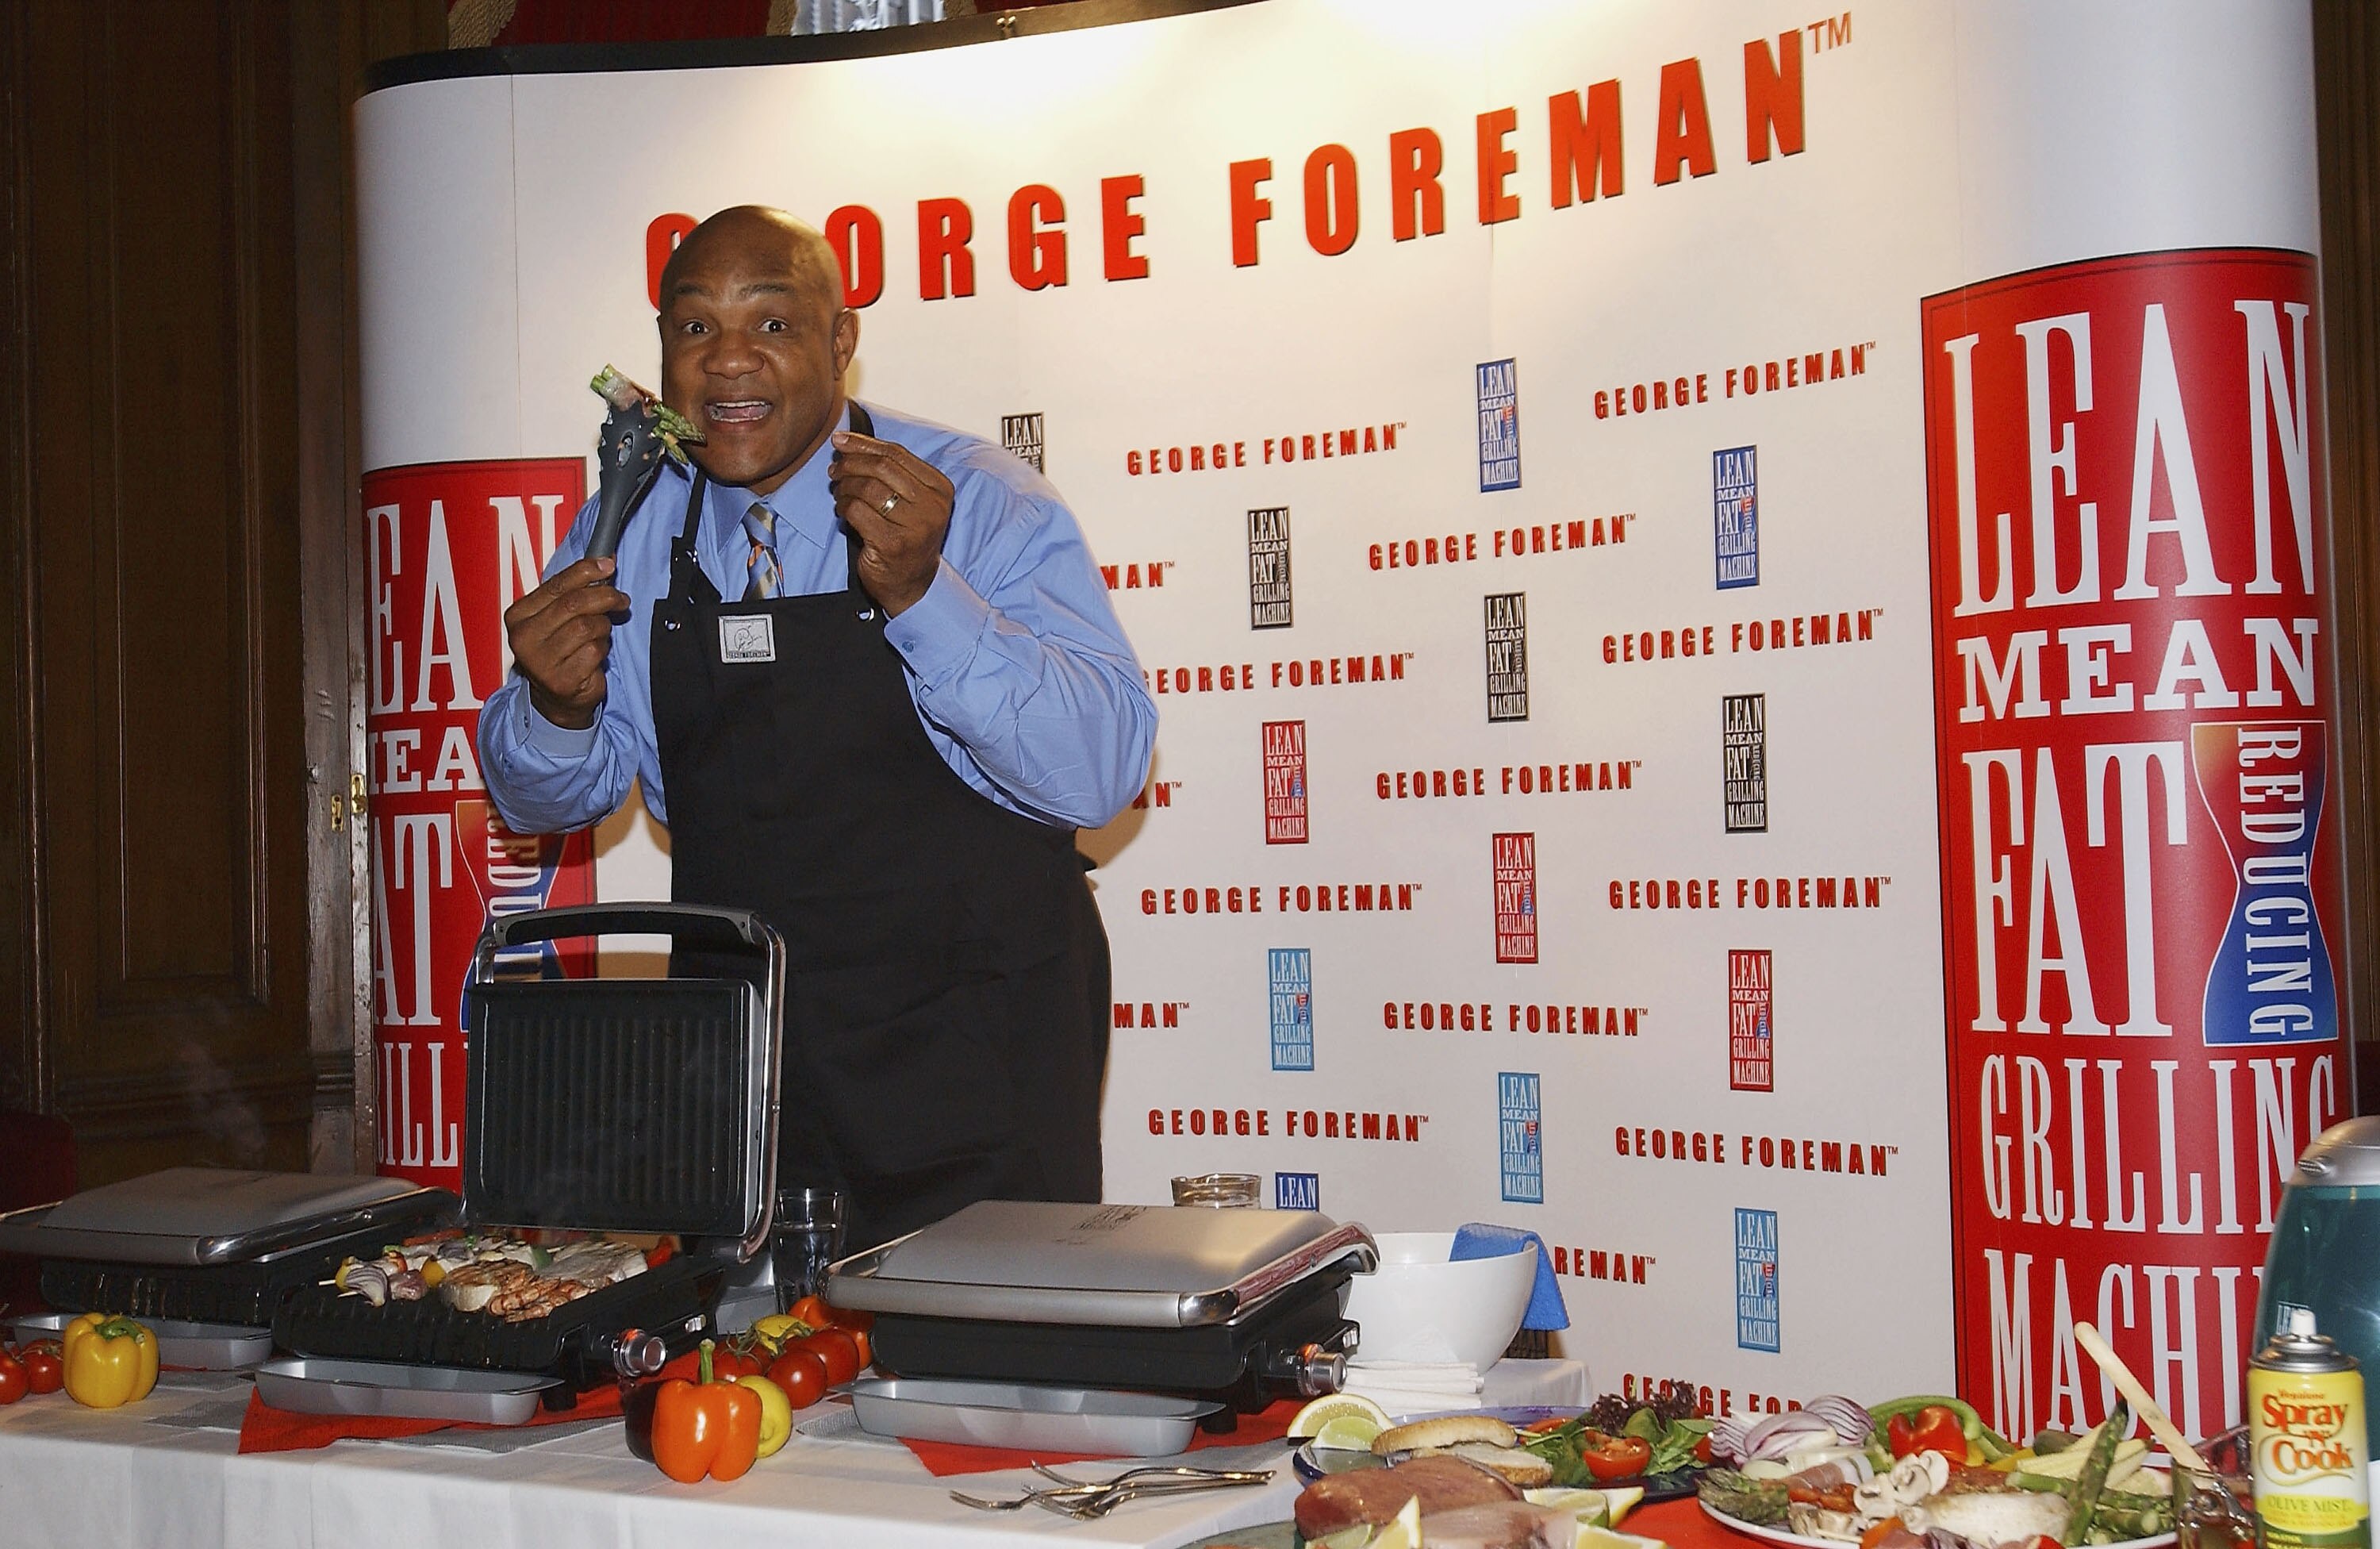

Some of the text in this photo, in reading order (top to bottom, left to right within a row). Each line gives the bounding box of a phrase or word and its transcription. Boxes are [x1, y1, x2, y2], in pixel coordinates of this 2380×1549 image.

[1480, 363, 1514, 398] LEAN
[1480, 396, 1514, 409] MEAN
[1594, 374, 1708, 420] GEORGE
[1004, 416, 1042, 447] LEAN
[1481, 409, 1503, 442] FAT
[1127, 442, 1246, 476] GEORGE
[1484, 438, 1517, 461] GRILLING
[1944, 300, 2315, 617] LEAN
[1484, 459, 1518, 485] MACHINE
[1717, 451, 1754, 489] LEAN
[1718, 486, 1755, 501] MEAN
[1250, 510, 1288, 541] LEAN
[1718, 500, 1741, 535] FAT
[1252, 541, 1288, 552] MEAN
[1368, 533, 1477, 571] GEORGE
[1719, 532, 1756, 555] GRILLING
[1253, 553, 1275, 583] FAT
[1720, 555, 1756, 581] MACHINE
[367, 495, 564, 715] EAN
[1254, 583, 1290, 602] GRILLING
[1254, 602, 1290, 625] MACHINE
[1488, 597, 1524, 629] LEAN
[1488, 628, 1524, 641] MEAN
[1603, 626, 1714, 664] GEORGE
[1489, 642, 1511, 674] FAT
[1956, 618, 2318, 723] MEAN
[1143, 664, 1254, 694] EORGE
[1491, 673, 1526, 694] GRILLING
[1491, 694, 1526, 717] MACHINE
[1726, 698, 1763, 732] LEAN
[1266, 725, 1303, 755] LEAN
[1726, 732, 1763, 745] MEAN
[1267, 755, 1303, 766] MEAN
[1726, 746, 1749, 781] FAT
[1268, 767, 1291, 798] FAT
[1376, 768, 1485, 800] GEORGE
[1728, 781, 1764, 801] GRILLING
[1269, 798, 1304, 817] GRILLING
[1729, 803, 1764, 827] MACHINE
[1269, 817, 1305, 839] MACHINE
[1496, 837, 1533, 869] LEAN
[1497, 870, 1533, 881] MEAN
[1963, 726, 2314, 1040] FAT REDUCING
[1141, 886, 1261, 915] GEORGE
[1498, 882, 1520, 913] FAT
[1609, 878, 1719, 909] GEORGE
[374, 813, 452, 1025] AT
[1499, 914, 1534, 933] GRILLING
[1500, 936, 1534, 957] MACHINE
[1272, 952, 1309, 982] LEAN
[1732, 955, 1769, 989] LEAN
[1273, 983, 1309, 993] MEAN
[1733, 990, 1768, 1001] MEAN
[1274, 995, 1296, 1024] FAT
[1384, 1001, 1492, 1032] GEORGE
[1733, 1003, 1756, 1037] FAT
[1275, 1025, 1310, 1044] GRILLING
[1733, 1038, 1769, 1059] GRILLING
[1275, 1044, 1311, 1066] MACHINE
[1734, 1060, 1769, 1085] MACHINE
[1502, 1077, 1538, 1109] LEAN
[1148, 1109, 1269, 1136] GEORGE
[1503, 1109, 1538, 1120] MEAN
[1503, 1121, 1526, 1153] FAT
[1615, 1126, 1725, 1163] GEORGE
[1505, 1154, 1540, 1174] GRILLING
[1279, 1177, 1316, 1208] LEAN
[1505, 1174, 1540, 1197] MACHINE
[1738, 1213, 1775, 1250] LEAN
[1739, 1248, 1775, 1262] MEAN
[1740, 1261, 1762, 1296] FAT
[1741, 1297, 1775, 1320] GRILLING
[1741, 1319, 1776, 1346] MACHINE
[1984, 1248, 2264, 1446] MACHI
[1622, 1373, 1732, 1419] GEOGE
[2262, 1393, 2349, 1433] Spray
[2272, 1439, 2354, 1474] Cook
[2267, 1496, 2308, 1511] OLIVE
